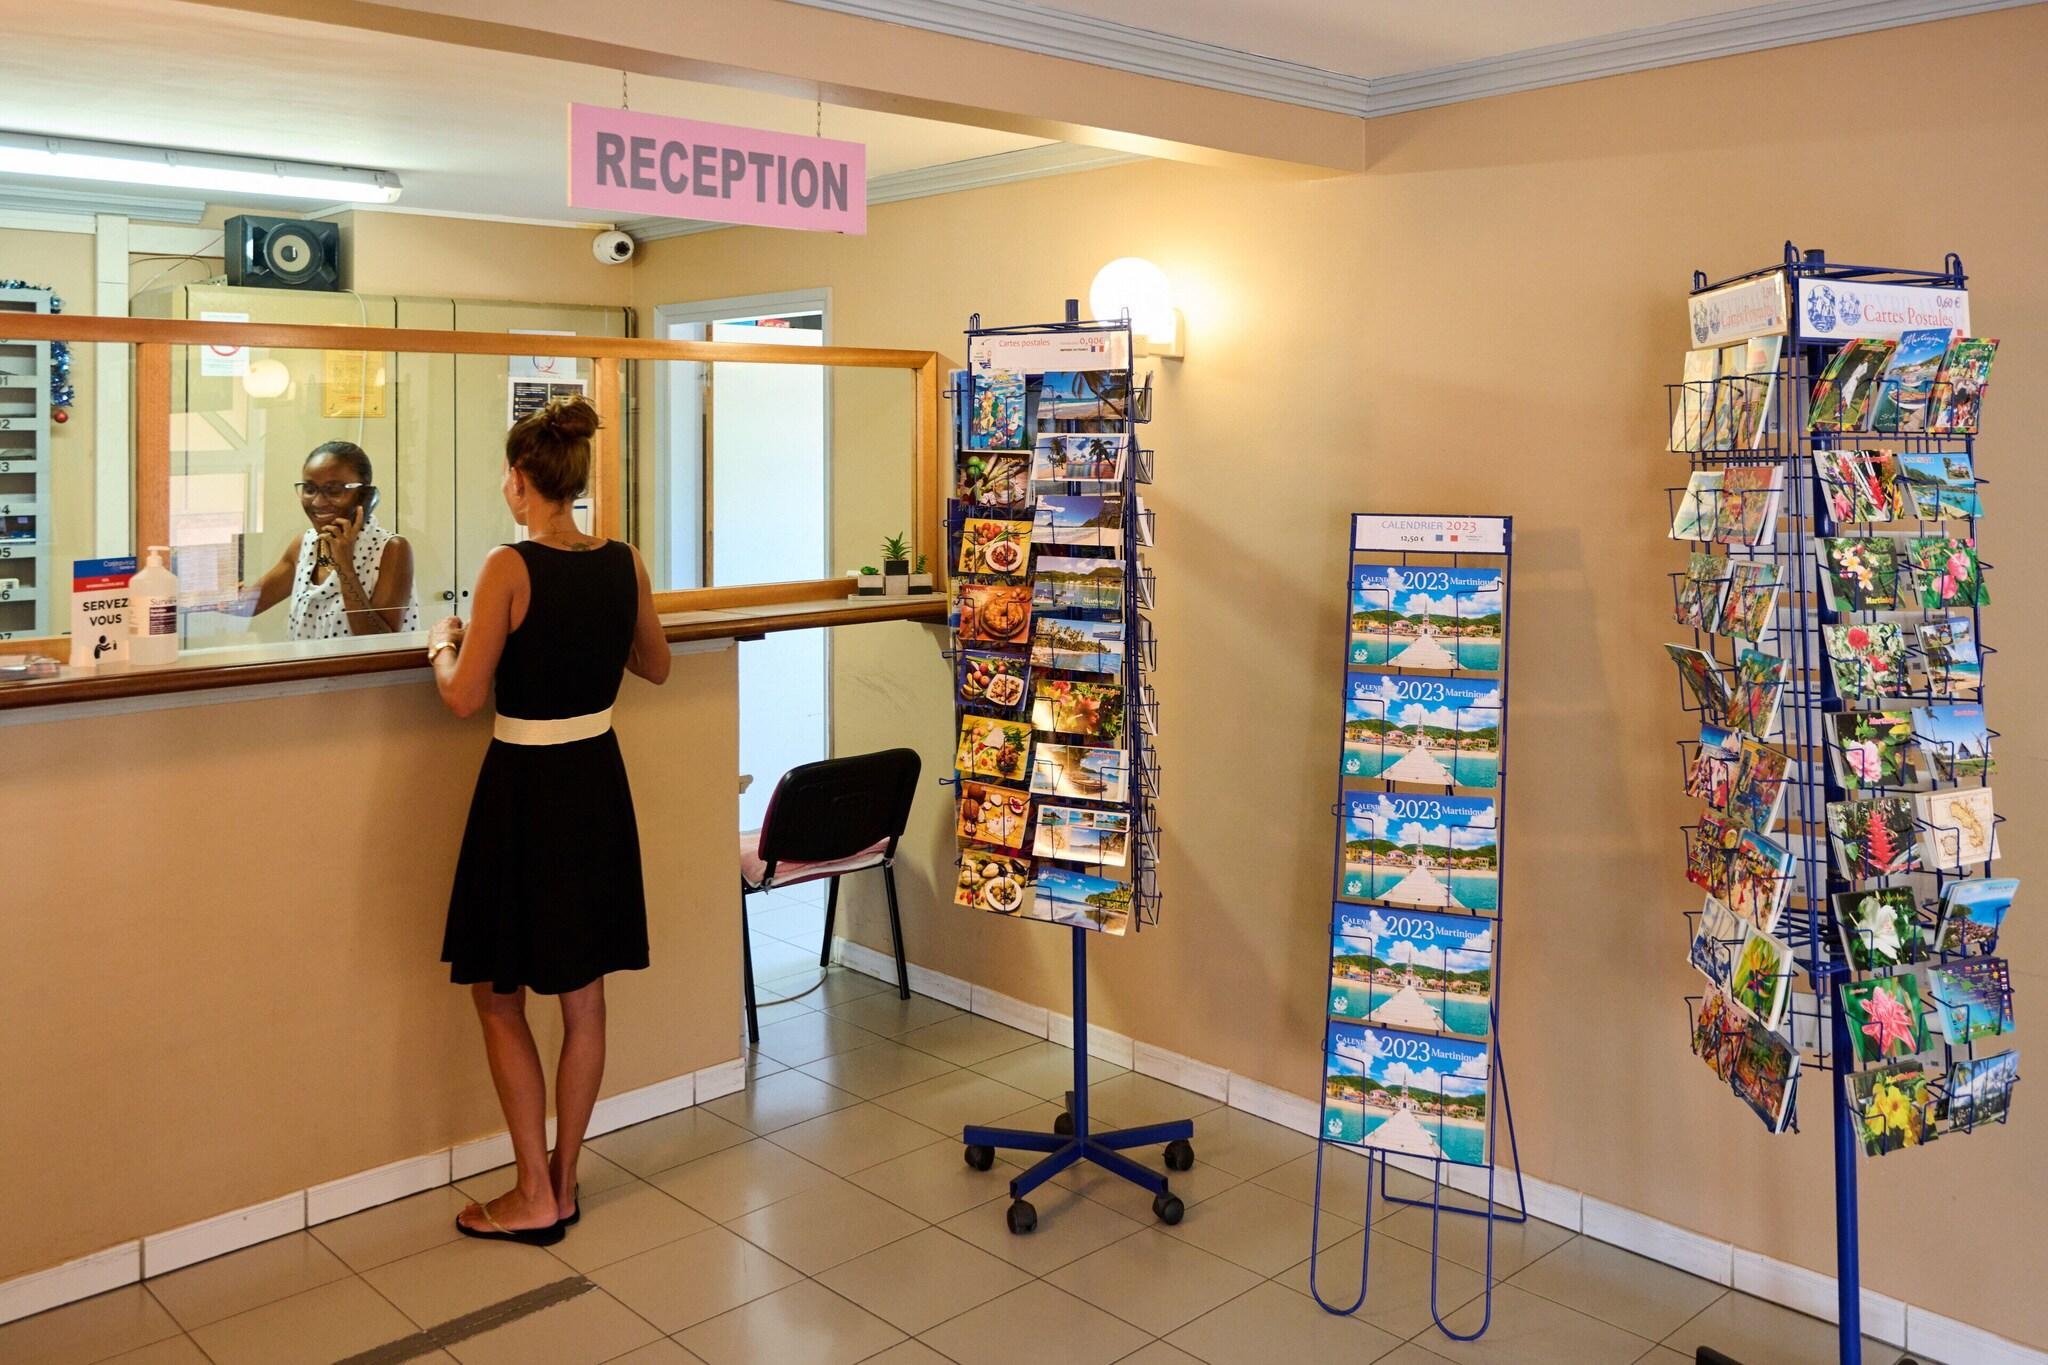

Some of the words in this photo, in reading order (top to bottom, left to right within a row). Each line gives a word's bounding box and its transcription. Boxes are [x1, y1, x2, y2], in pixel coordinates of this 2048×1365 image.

[597, 131, 848, 212] RECEPTION
[1863, 304, 1905, 324] Cartes
[1907, 306, 1954, 327] Postales
[998, 339, 1020, 347] Cartes
[1021, 337, 1050, 349] postales
[0, 419, 10, 429] 2
[0, 462, 10, 472] 3
[0, 504, 10, 514] 4
[1381, 520, 1444, 530] CALENDRIER
[1446, 520, 1477, 534] 2023
[1400, 535, 1419, 543] 12,50
[1404, 571, 1449, 591] 2023
[0, 589, 10, 600] 6
[1082, 596, 1116, 607] Martnique
[83, 597, 128, 612] SERVEZ
[90, 613, 122, 627] VOUS
[1397, 680, 1445, 702] 2023
[1394, 799, 1441, 820] 2023
[1385, 915, 1435, 940] 2023
[1381, 1035, 1431, 1063] 2023
